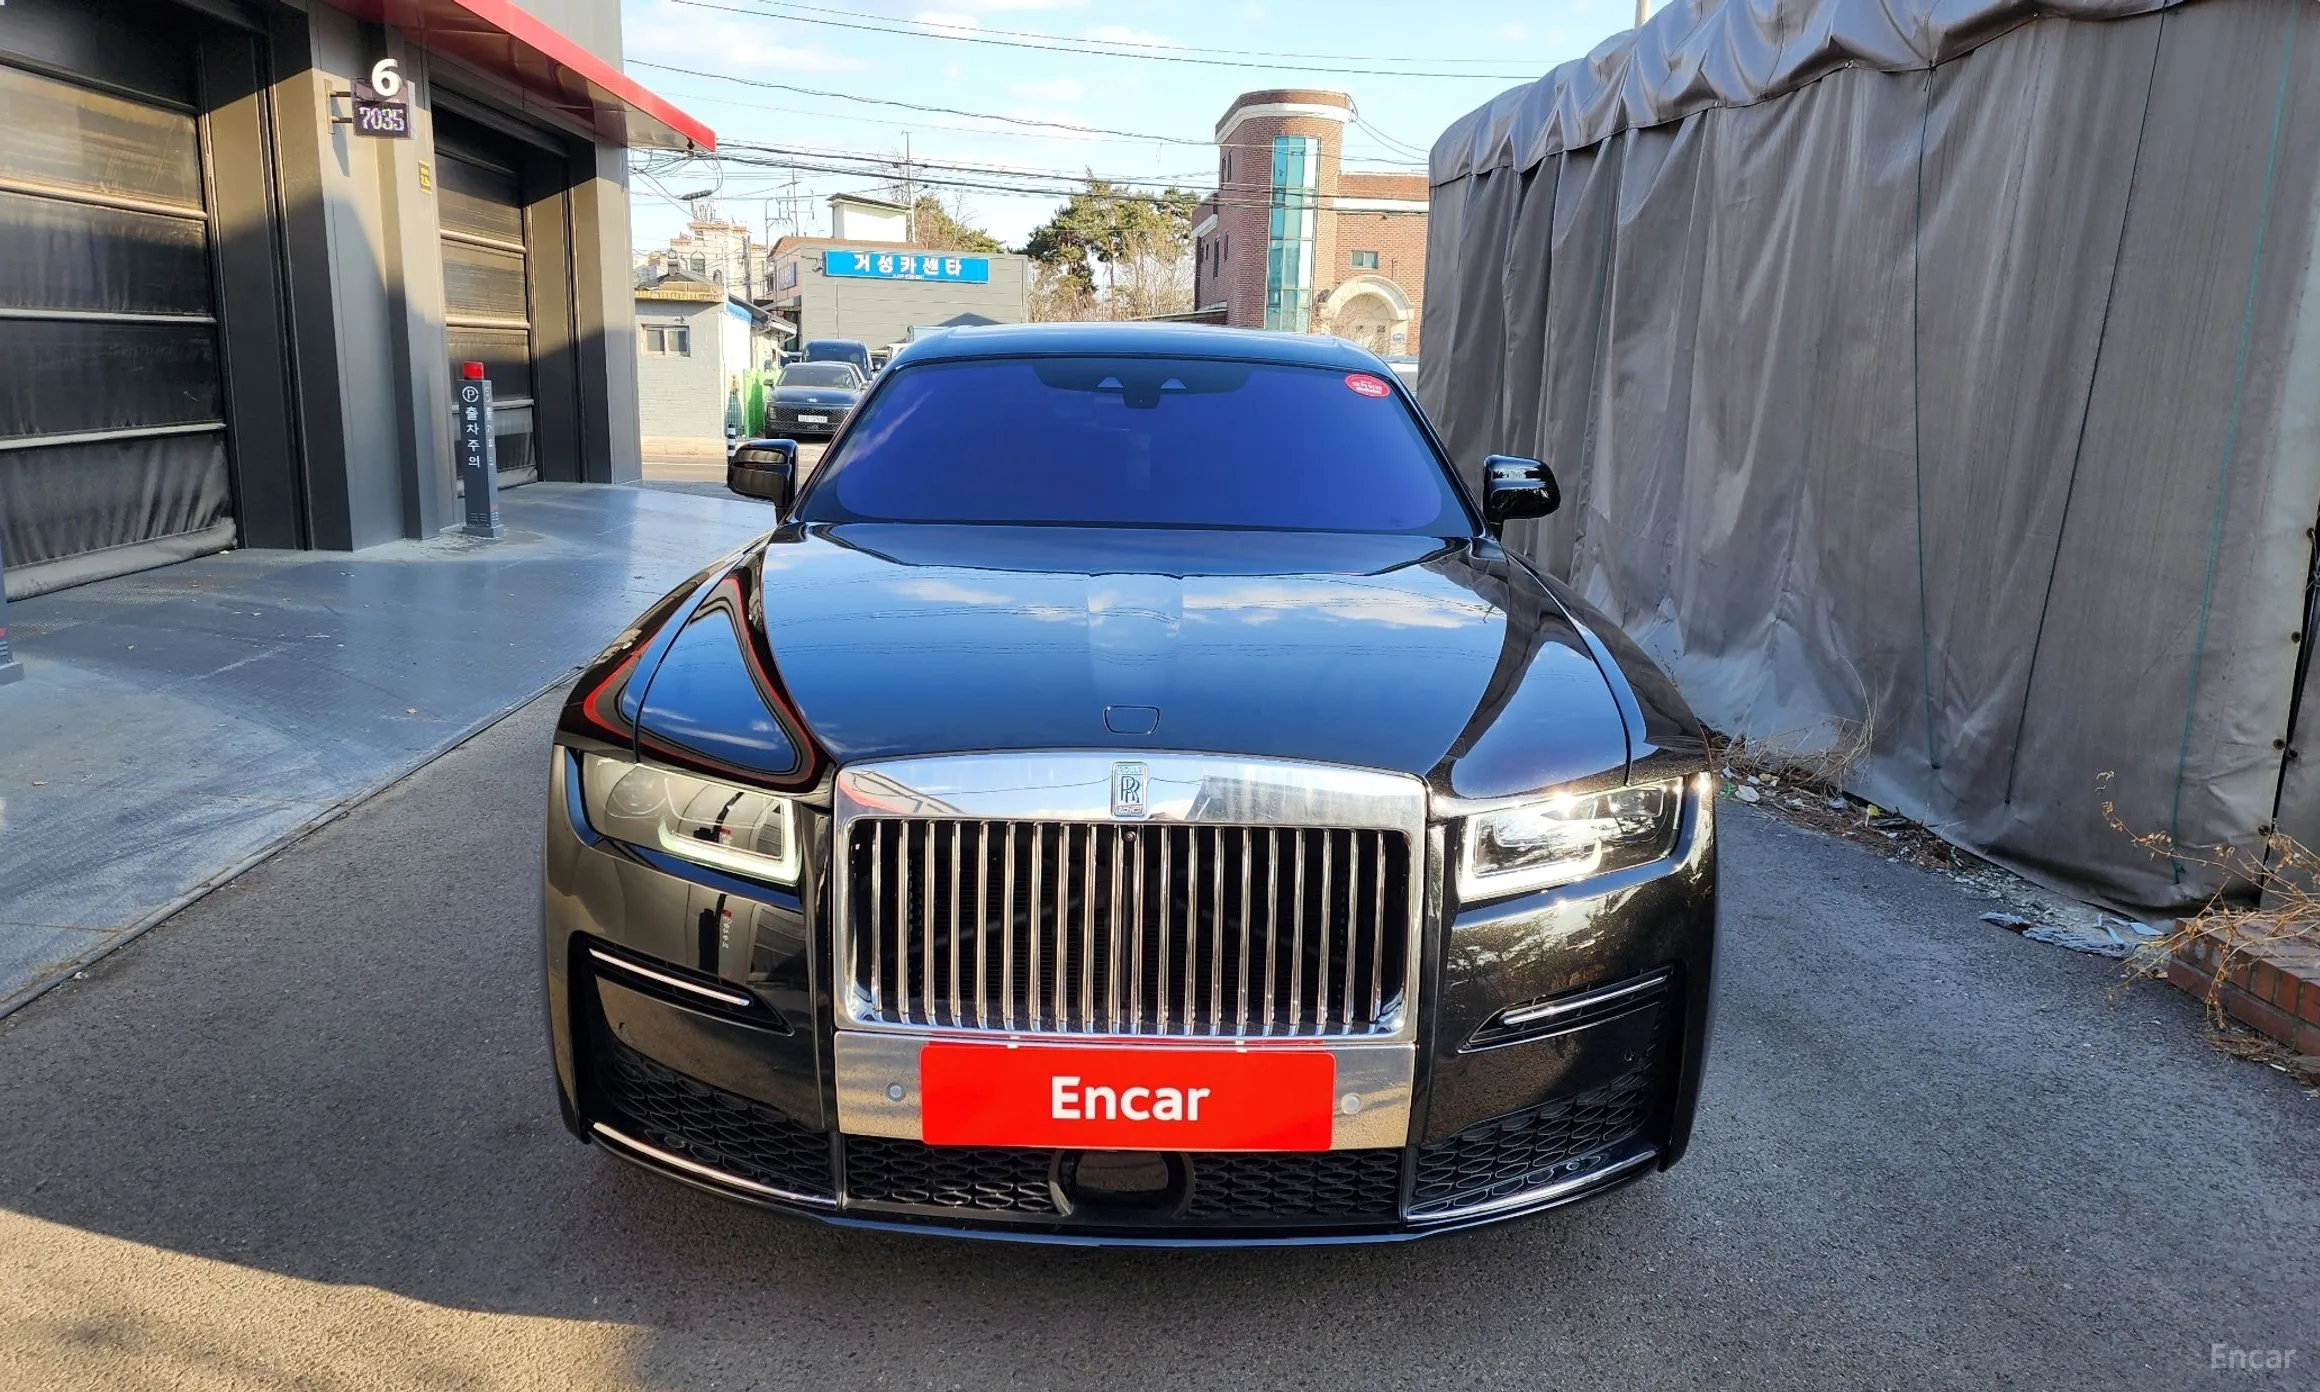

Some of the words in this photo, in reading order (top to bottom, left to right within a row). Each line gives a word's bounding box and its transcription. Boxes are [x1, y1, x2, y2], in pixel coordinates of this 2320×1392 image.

[372, 58, 401, 97] 6
[359, 107, 405, 132] 7035
[853, 253, 962, 277] 거성카센타
[465, 405, 481, 468] 출차주의
[1051, 1075, 1211, 1121] Encar
